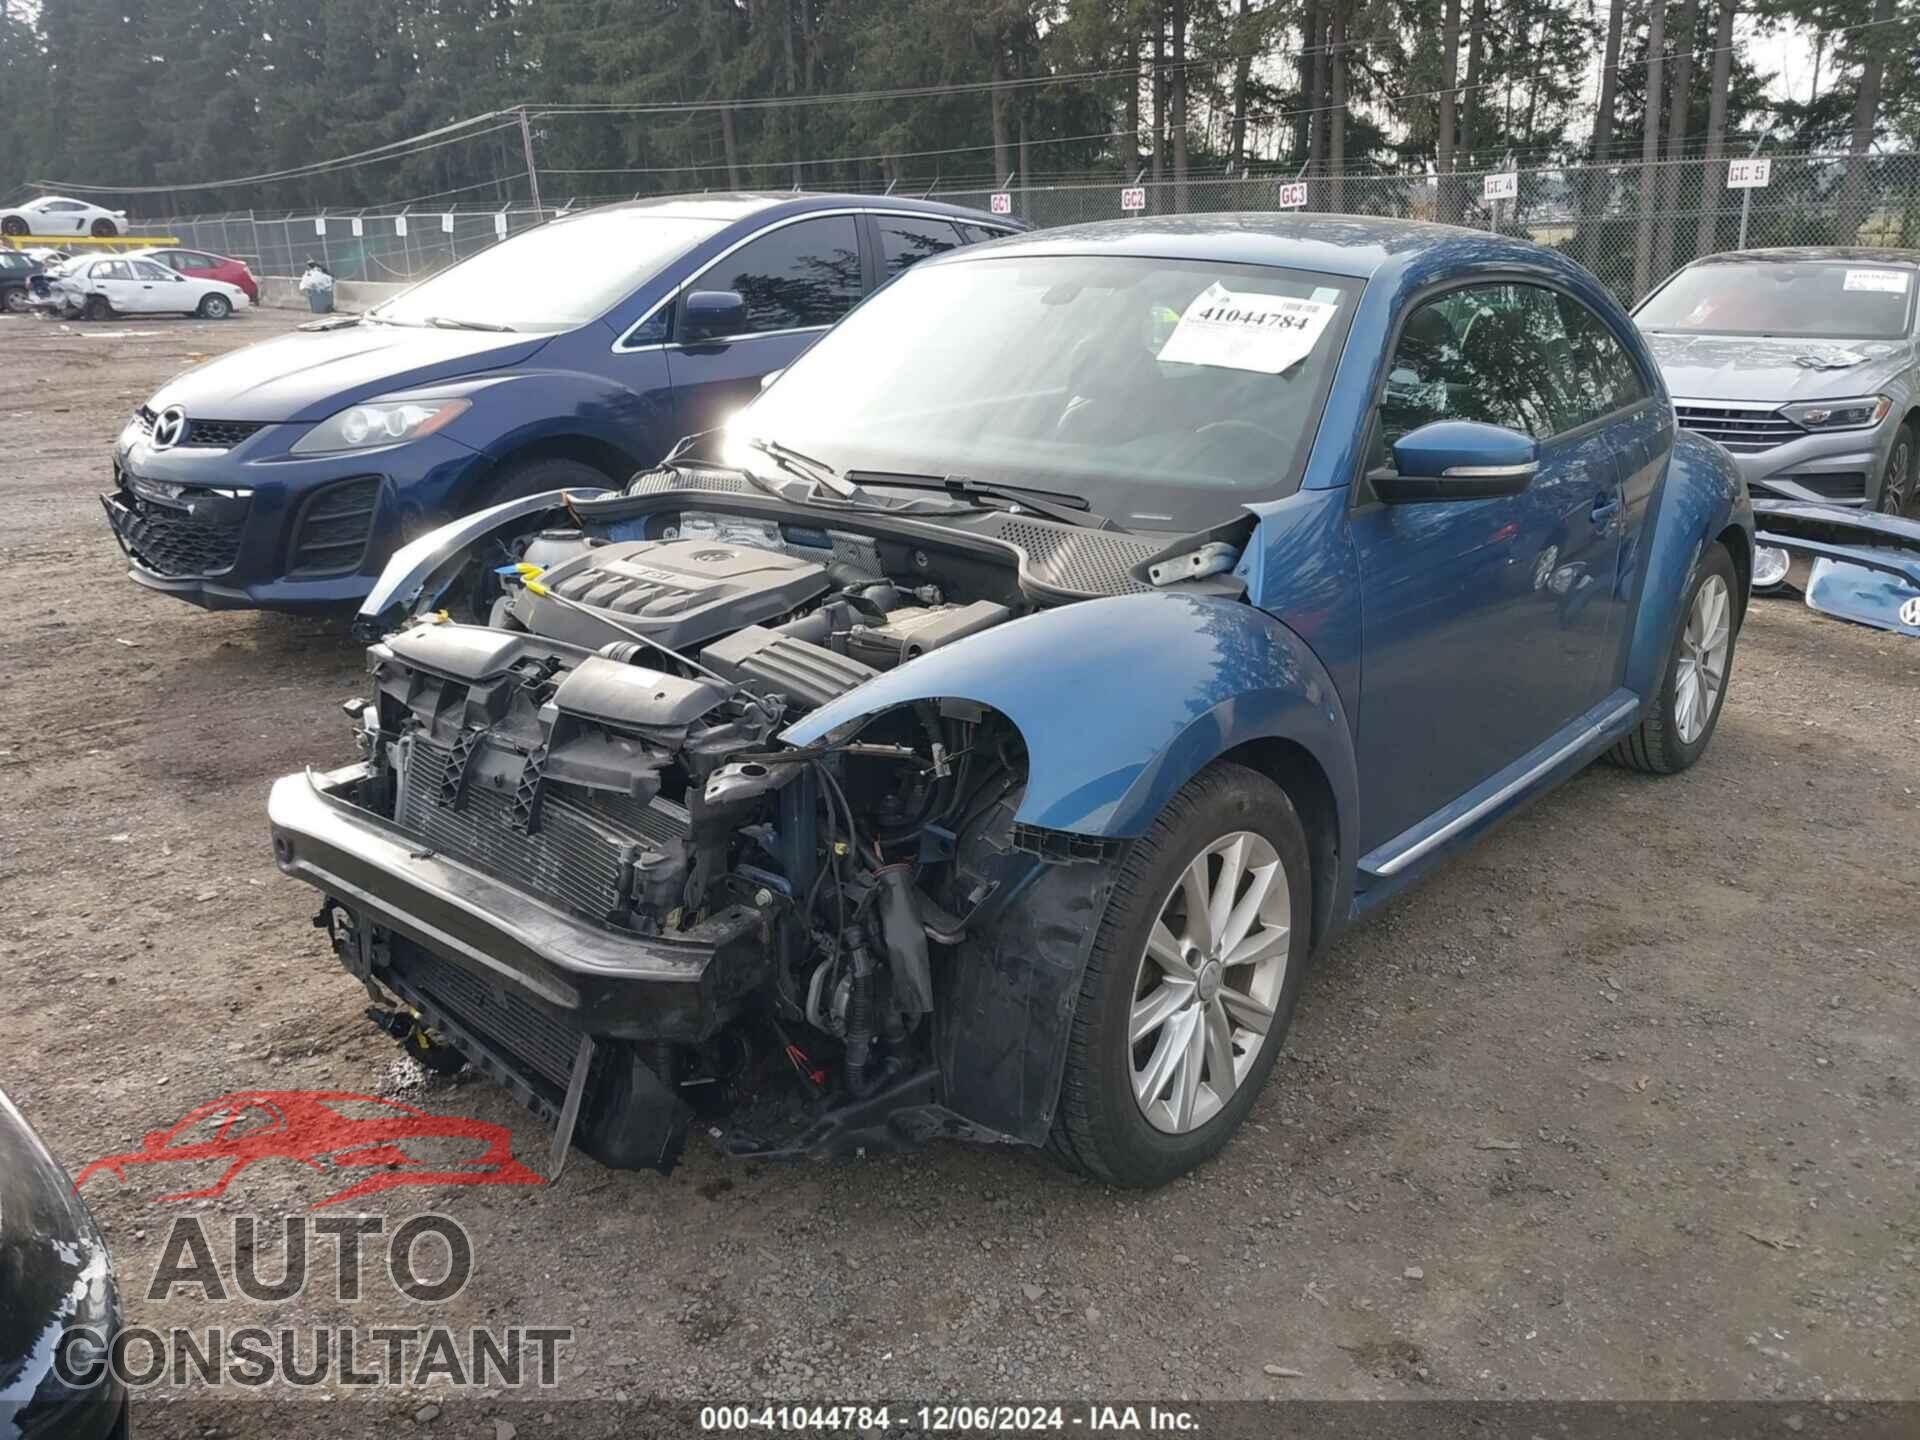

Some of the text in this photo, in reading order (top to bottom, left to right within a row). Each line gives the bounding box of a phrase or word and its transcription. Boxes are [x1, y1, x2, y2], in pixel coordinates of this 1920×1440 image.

[1123, 190, 1144, 207] GC2
[1281, 185, 1305, 205] GC3
[1199, 307, 1310, 331] 41044784
